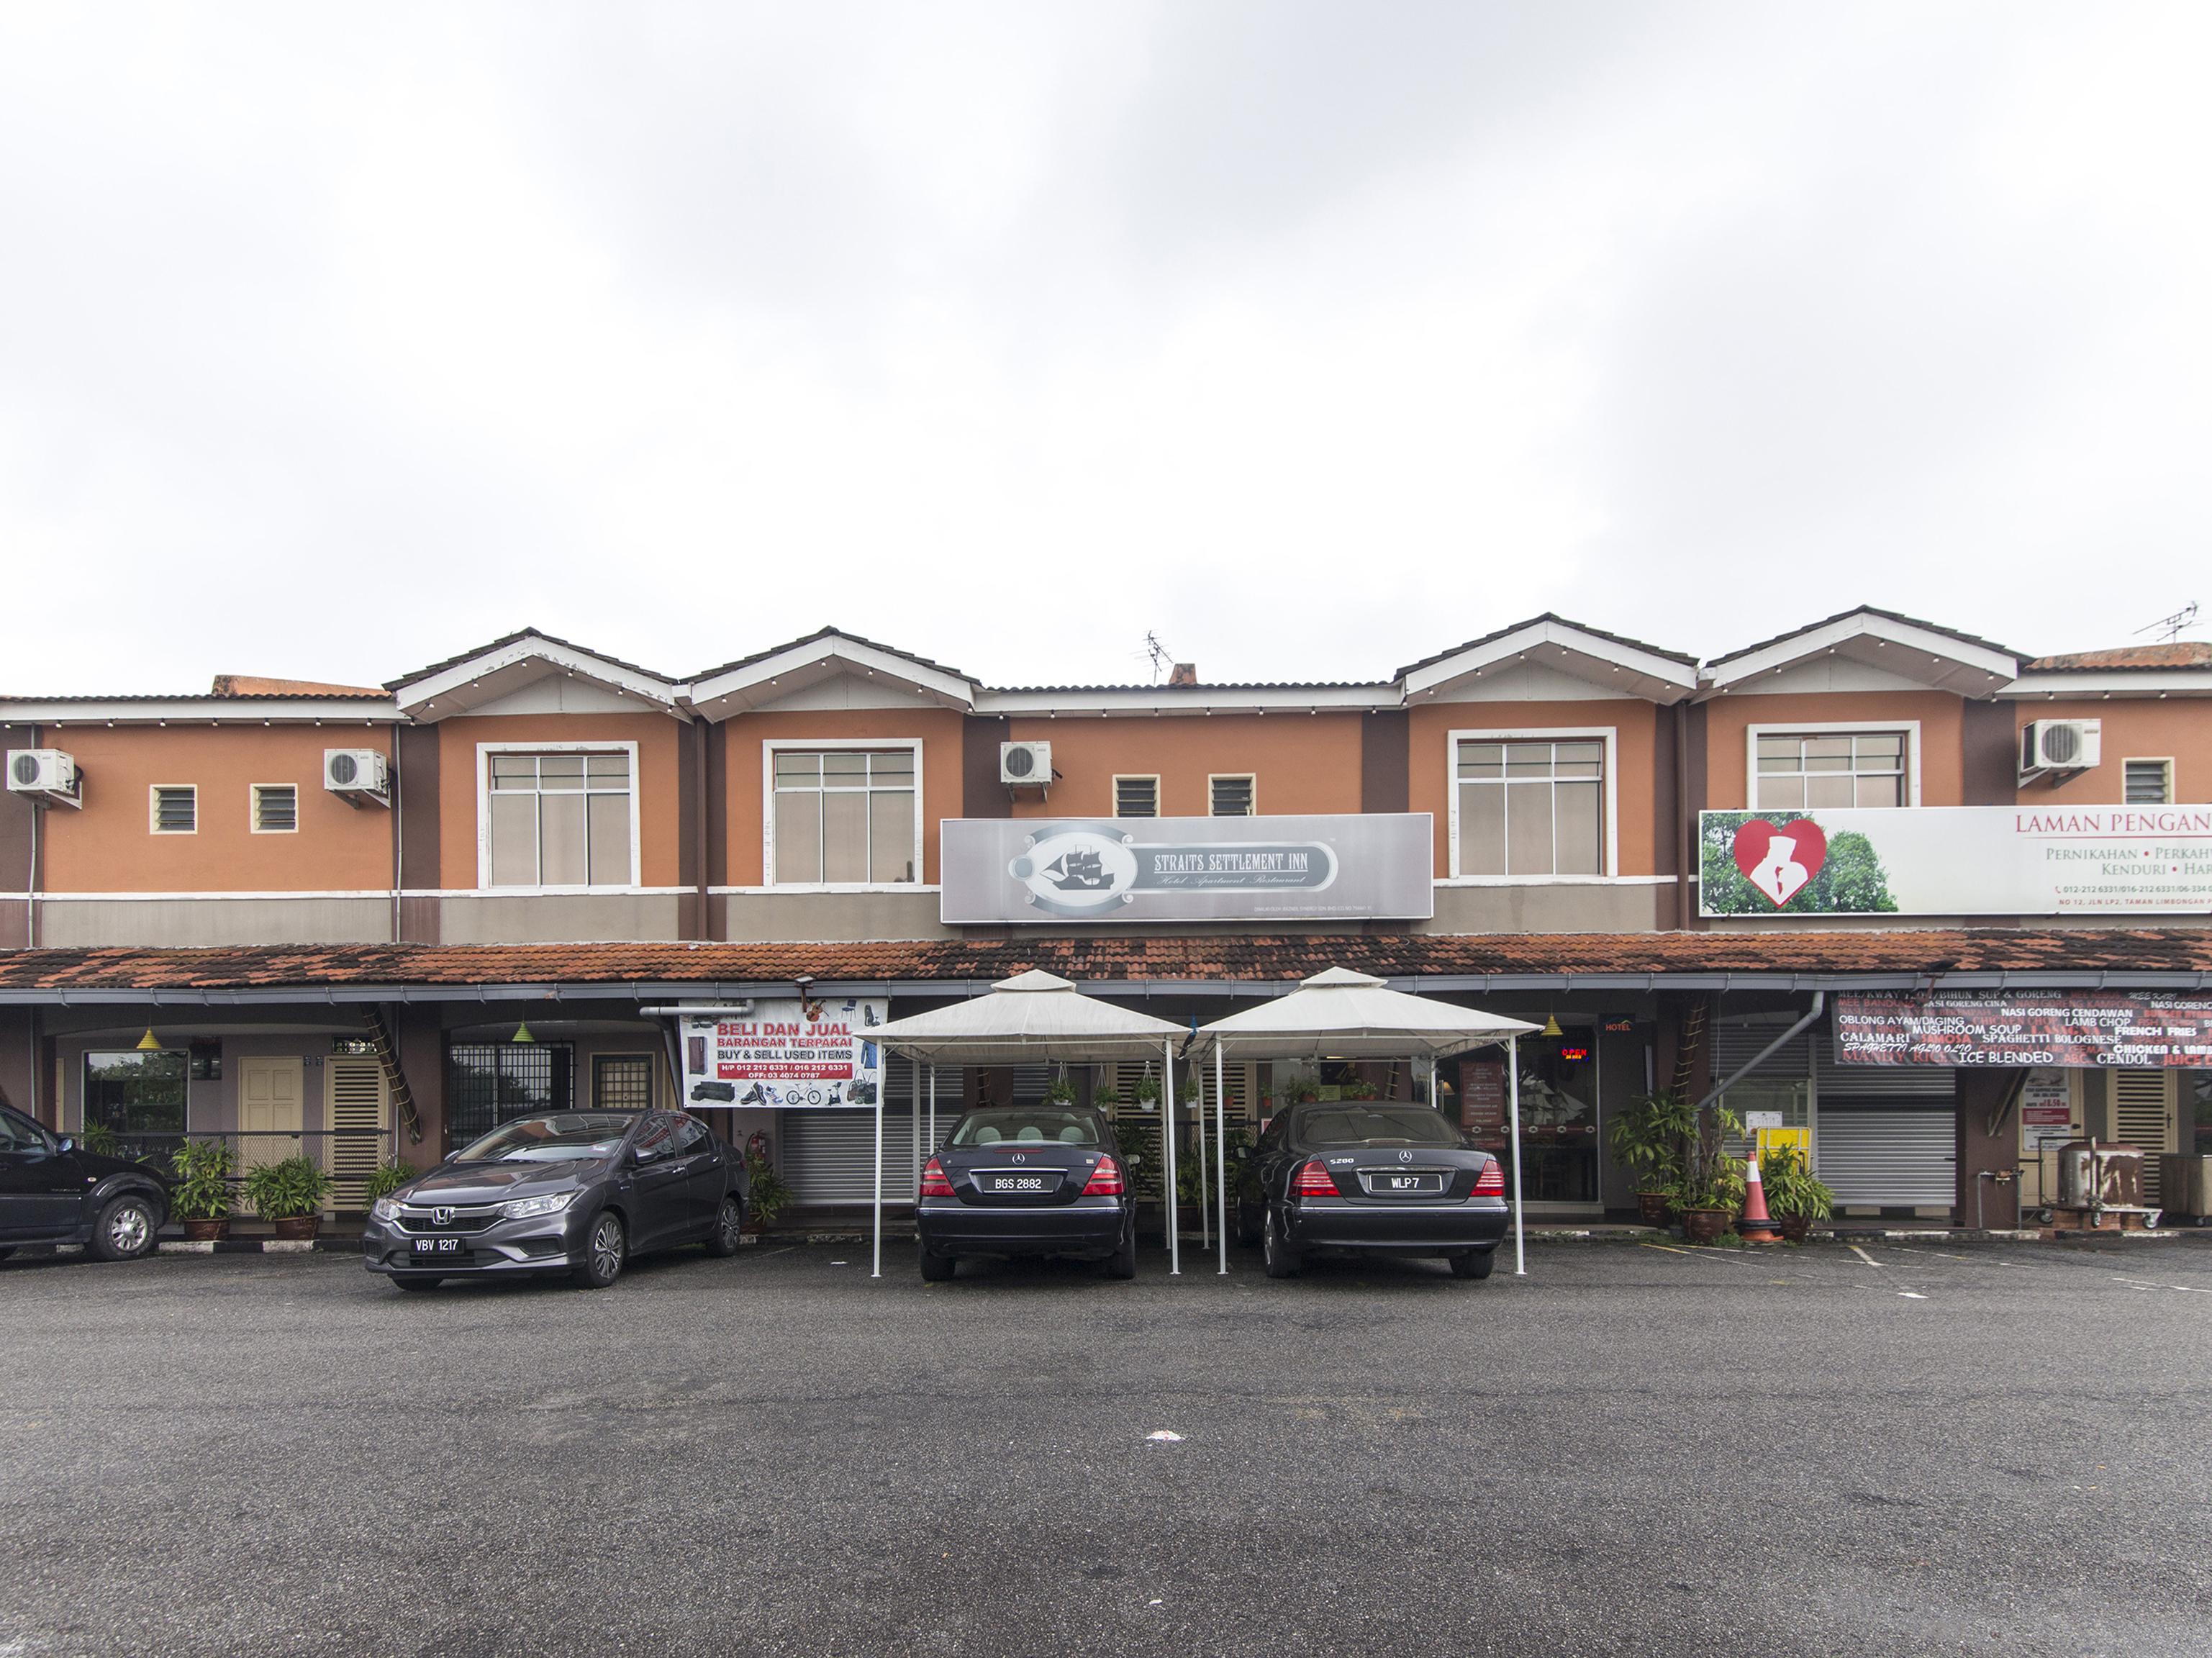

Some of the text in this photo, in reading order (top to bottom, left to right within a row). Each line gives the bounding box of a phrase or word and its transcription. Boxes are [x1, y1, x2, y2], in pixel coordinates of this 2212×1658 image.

[2016, 812, 2211, 833] LAMAN PENGAN
[2046, 847, 2212, 860] PERNIKAHAN PERKAH
[1154, 853, 1307, 871] STRAITS SETTLEMENT INN
[2102, 864, 2166, 875] KENDURI
[1156, 875, 1306, 887] Hotel Apartment Restaurant
[2016, 990, 2062, 999] GORENG
[1864, 999, 1915, 1007] BANDUNG
[2027, 1008, 2070, 1017] GORENG
[2072, 1009, 2133, 1018] CENDAWAN
[1839, 1015, 1884, 1025] OBLONG
[1887, 1016, 1964, 1025] AYAM/DAGING
[1972, 1017, 2024, 1025] CHICKEN
[2065, 1018, 2097, 1026] LAMB
[2099, 1018, 2131, 1026] CHOP
[717, 1023, 853, 1036] BELI DAN JUAL
[1839, 1025, 1871, 1033] ONION
[1912, 1025, 1985, 1035] MUSHROOM
[1989, 1025, 2021, 1034] SOUP
[2114, 1027, 2162, 1036] FRENCH
[2167, 1027, 2197, 1036] FRIES
[717, 1038, 853, 1047] BARANGAN TERPAKAI
[1840, 1033, 1910, 1043] CALAMARI
[1921, 1034, 1972, 1043] SAMOSA
[1982, 1033, 2050, 1043] SPAGHETTI
[2054, 1035, 2122, 1044] BOLOGNESE
[1844, 1043, 1907, 1054] SPAGHETTI
[2113, 1045, 2168, 1054] CHICKEN
[2172, 1046, 2181, 1054] &
[718, 1050, 852, 1059] BUY & SELL USED ITEMS
[1842, 1051, 1906, 1061] MANDY
[1913, 1052, 1947, 1062] RICE
[1959, 1052, 1984, 1063] ICE
[1988, 1051, 2053, 1064] BLENDED
[2097, 1054, 2152, 1064] CENDOL
[2164, 1055, 2202, 1066] JUICE
[995, 1178, 1041, 1190] BGS 2882
[415, 1239, 459, 1251] VBV 1217
